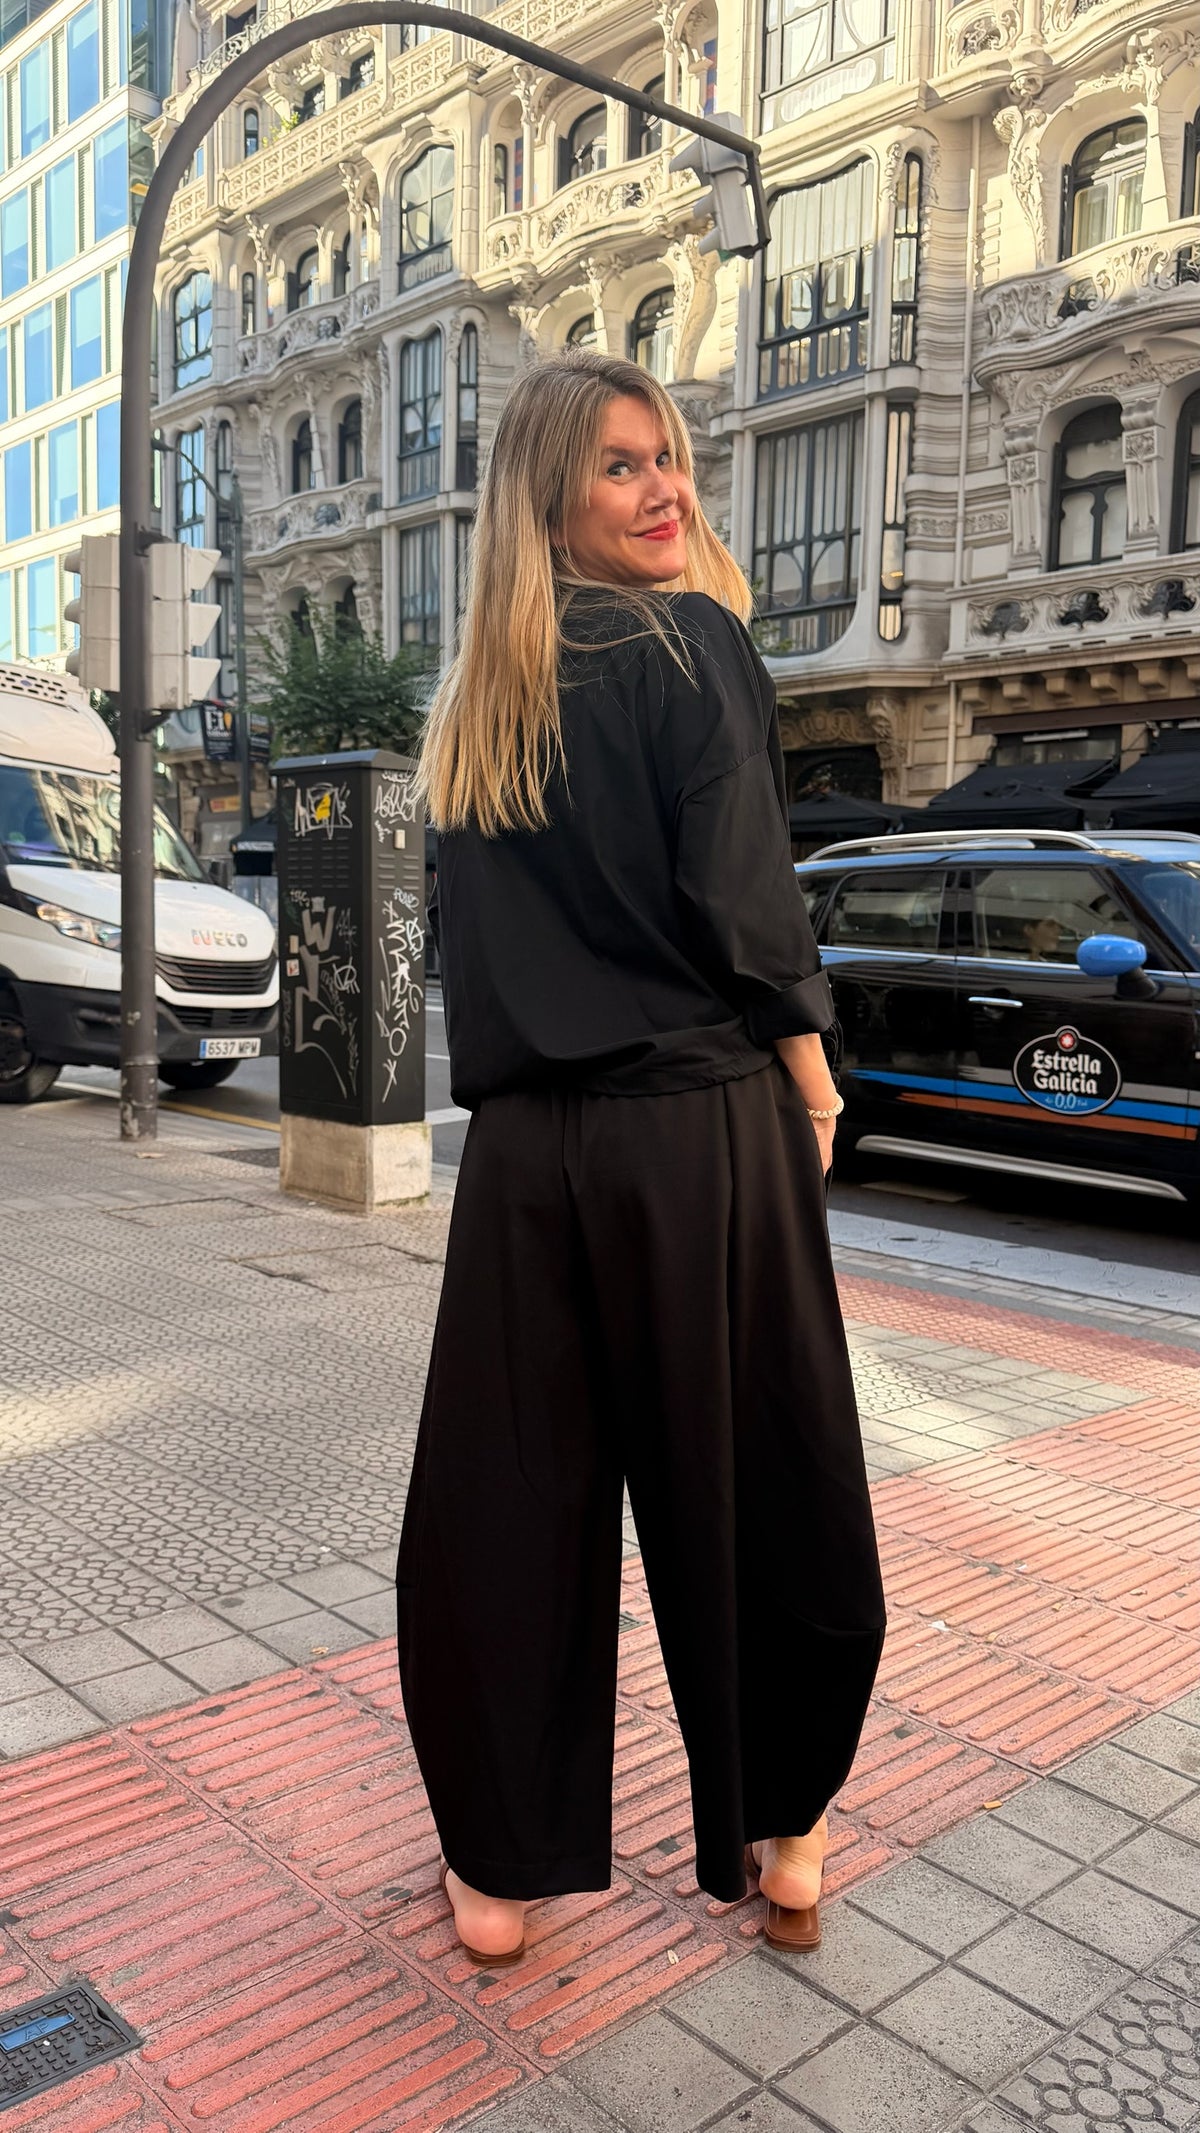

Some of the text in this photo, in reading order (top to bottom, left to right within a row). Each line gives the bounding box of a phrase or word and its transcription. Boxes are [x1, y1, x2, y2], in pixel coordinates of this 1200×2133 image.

[190, 929, 248, 948] IVECO
[206, 1041, 236, 1055] 6537
[1031, 1049, 1101, 1075] Estrella
[1033, 1069, 1098, 1095] Galicia
[24, 2022, 48, 2041] AP
